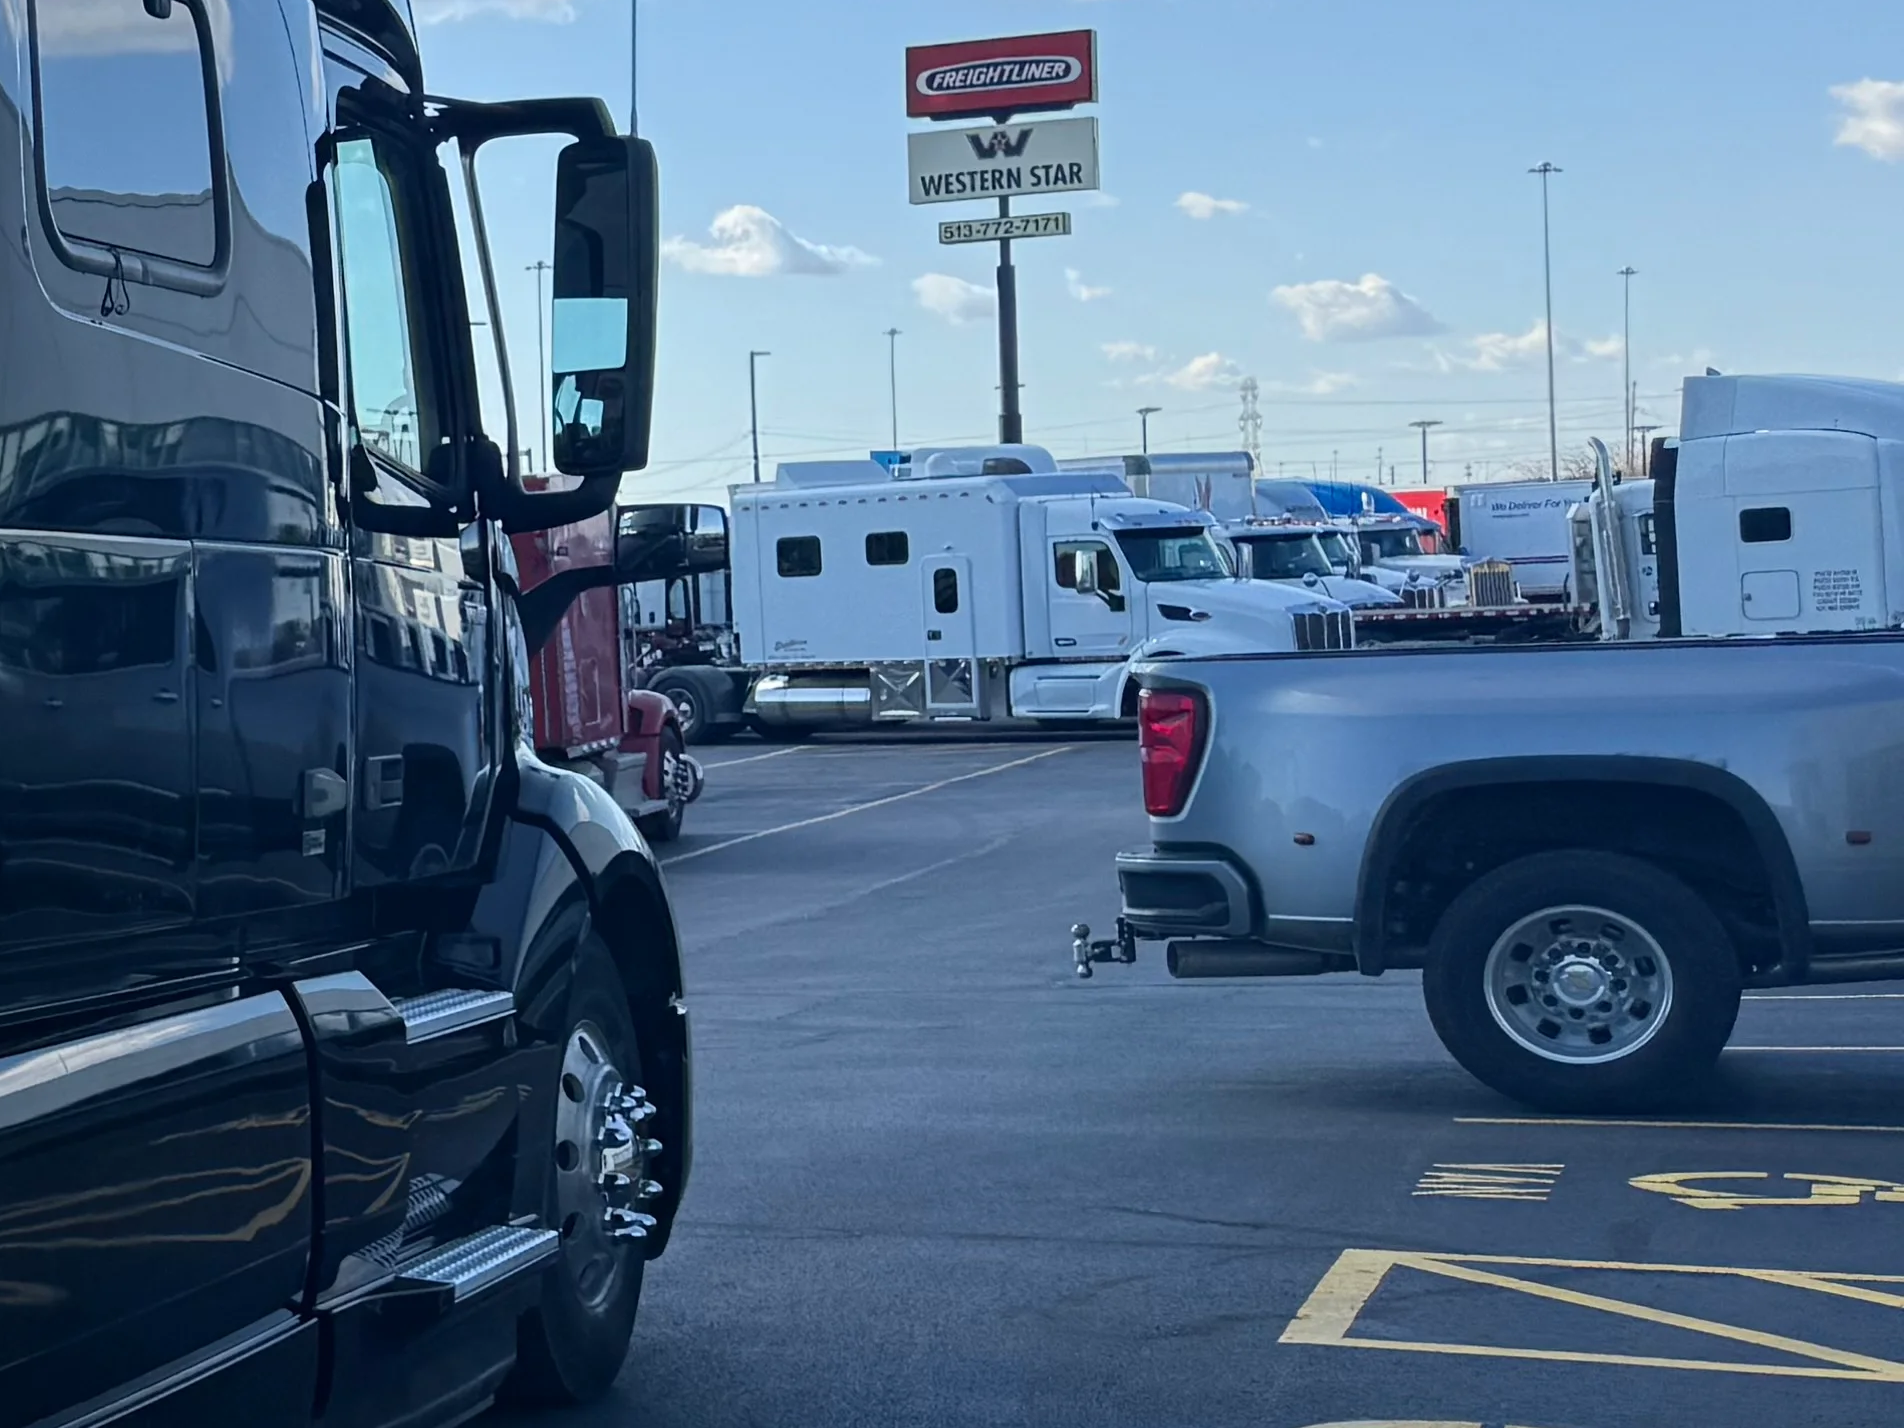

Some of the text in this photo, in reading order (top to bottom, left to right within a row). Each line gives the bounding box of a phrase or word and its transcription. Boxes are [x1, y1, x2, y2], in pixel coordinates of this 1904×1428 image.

[933, 62, 1066, 89] FREIGHTLINER
[921, 162, 1083, 197] WESTERN STAR
[943, 216, 1060, 239] 513-772-7171
